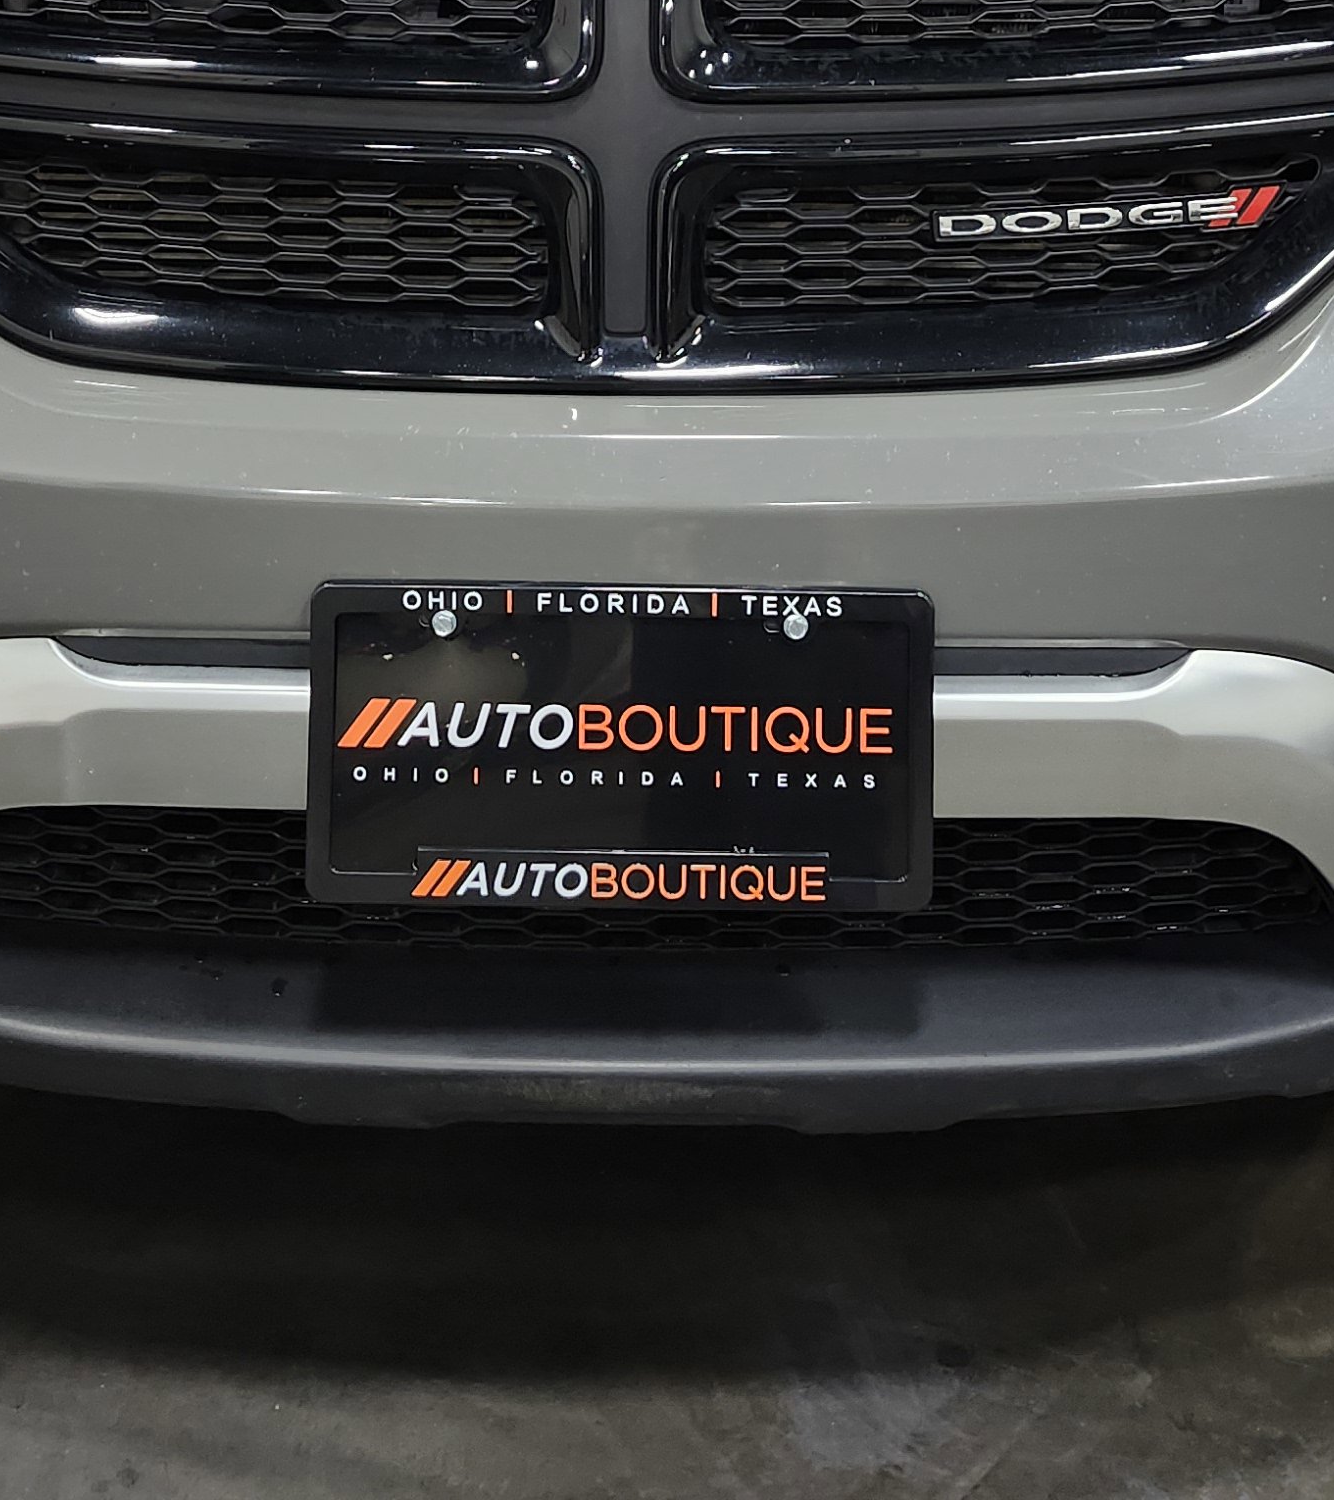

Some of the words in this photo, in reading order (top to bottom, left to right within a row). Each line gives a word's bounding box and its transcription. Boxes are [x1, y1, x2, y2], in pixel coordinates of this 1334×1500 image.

[938, 196, 1239, 237] DODGE
[402, 590, 484, 611] OHIO
[536, 592, 690, 614] FLORIDA
[741, 595, 844, 617] TEXAS
[396, 701, 894, 754] AUTOBOUTIQUE
[352, 766, 449, 784] OHIO
[505, 768, 684, 787] FLORIDA
[747, 772, 876, 790] TEXAS
[455, 861, 827, 902] AUTOBOUTIQUE
